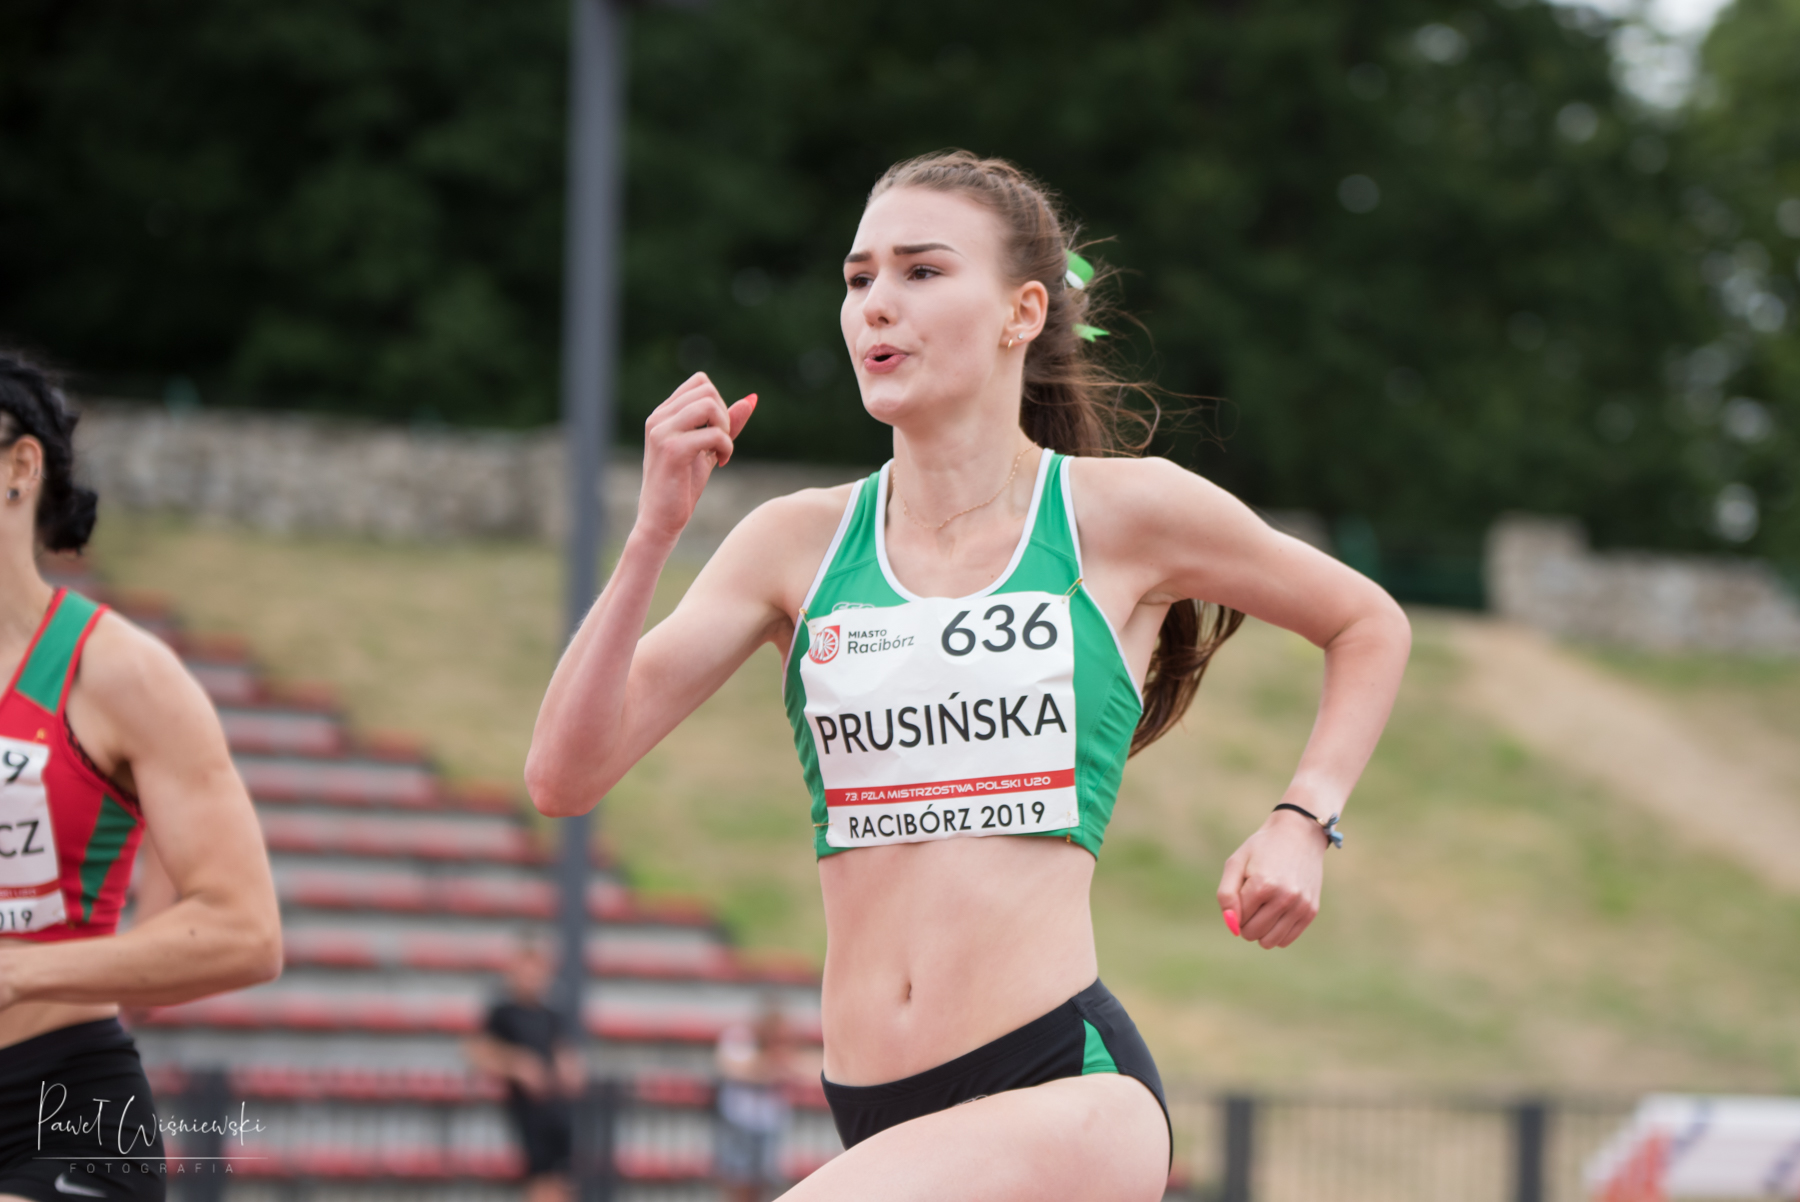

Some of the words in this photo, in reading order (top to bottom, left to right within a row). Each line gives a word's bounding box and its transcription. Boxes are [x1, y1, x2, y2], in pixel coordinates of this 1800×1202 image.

[847, 635, 915, 654] Racibórz
[848, 629, 887, 640] MIASTO
[941, 602, 1058, 656] 636
[815, 691, 1067, 755] PRUSIŃSKA
[2, 751, 30, 785] 9
[861, 791, 885, 801] PZLA
[887, 783, 974, 799] MISTRZOSTWA
[976, 779, 1021, 792] POLSKI
[1024, 776, 1051, 788] U20
[849, 803, 972, 839] RACIBÓRZ
[981, 801, 1045, 829] 2019
